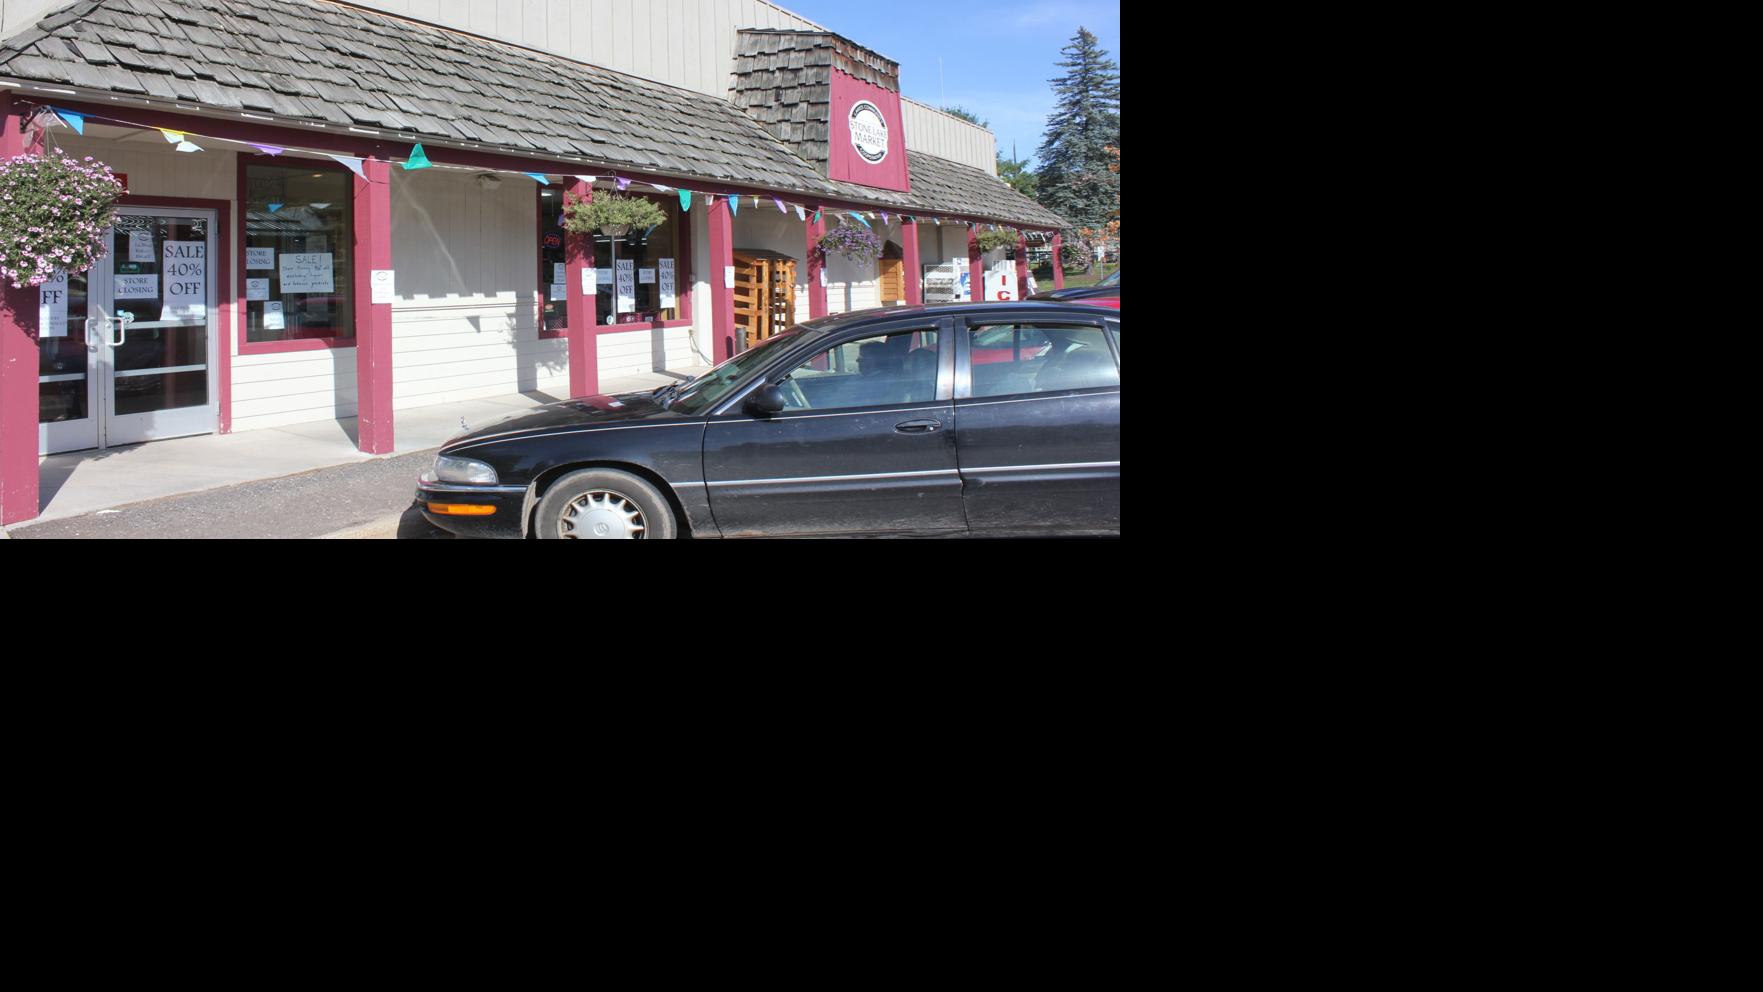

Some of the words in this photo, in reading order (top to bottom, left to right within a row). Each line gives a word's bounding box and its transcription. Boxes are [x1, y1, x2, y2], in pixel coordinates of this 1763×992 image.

[850, 121, 871, 132] STONE
[854, 132, 885, 148] MARKET
[164, 245, 204, 259] SALE
[167, 263, 202, 276] 40%
[617, 262, 633, 270] SALE
[660, 261, 673, 269] SALE
[618, 273, 633, 282] 40%
[661, 271, 673, 279] 40%
[118, 286, 154, 294] CLOSING
[169, 282, 201, 295] OFF
[619, 285, 633, 295] OFF
[662, 283, 673, 291] OFF
[41, 290, 63, 304] FF
